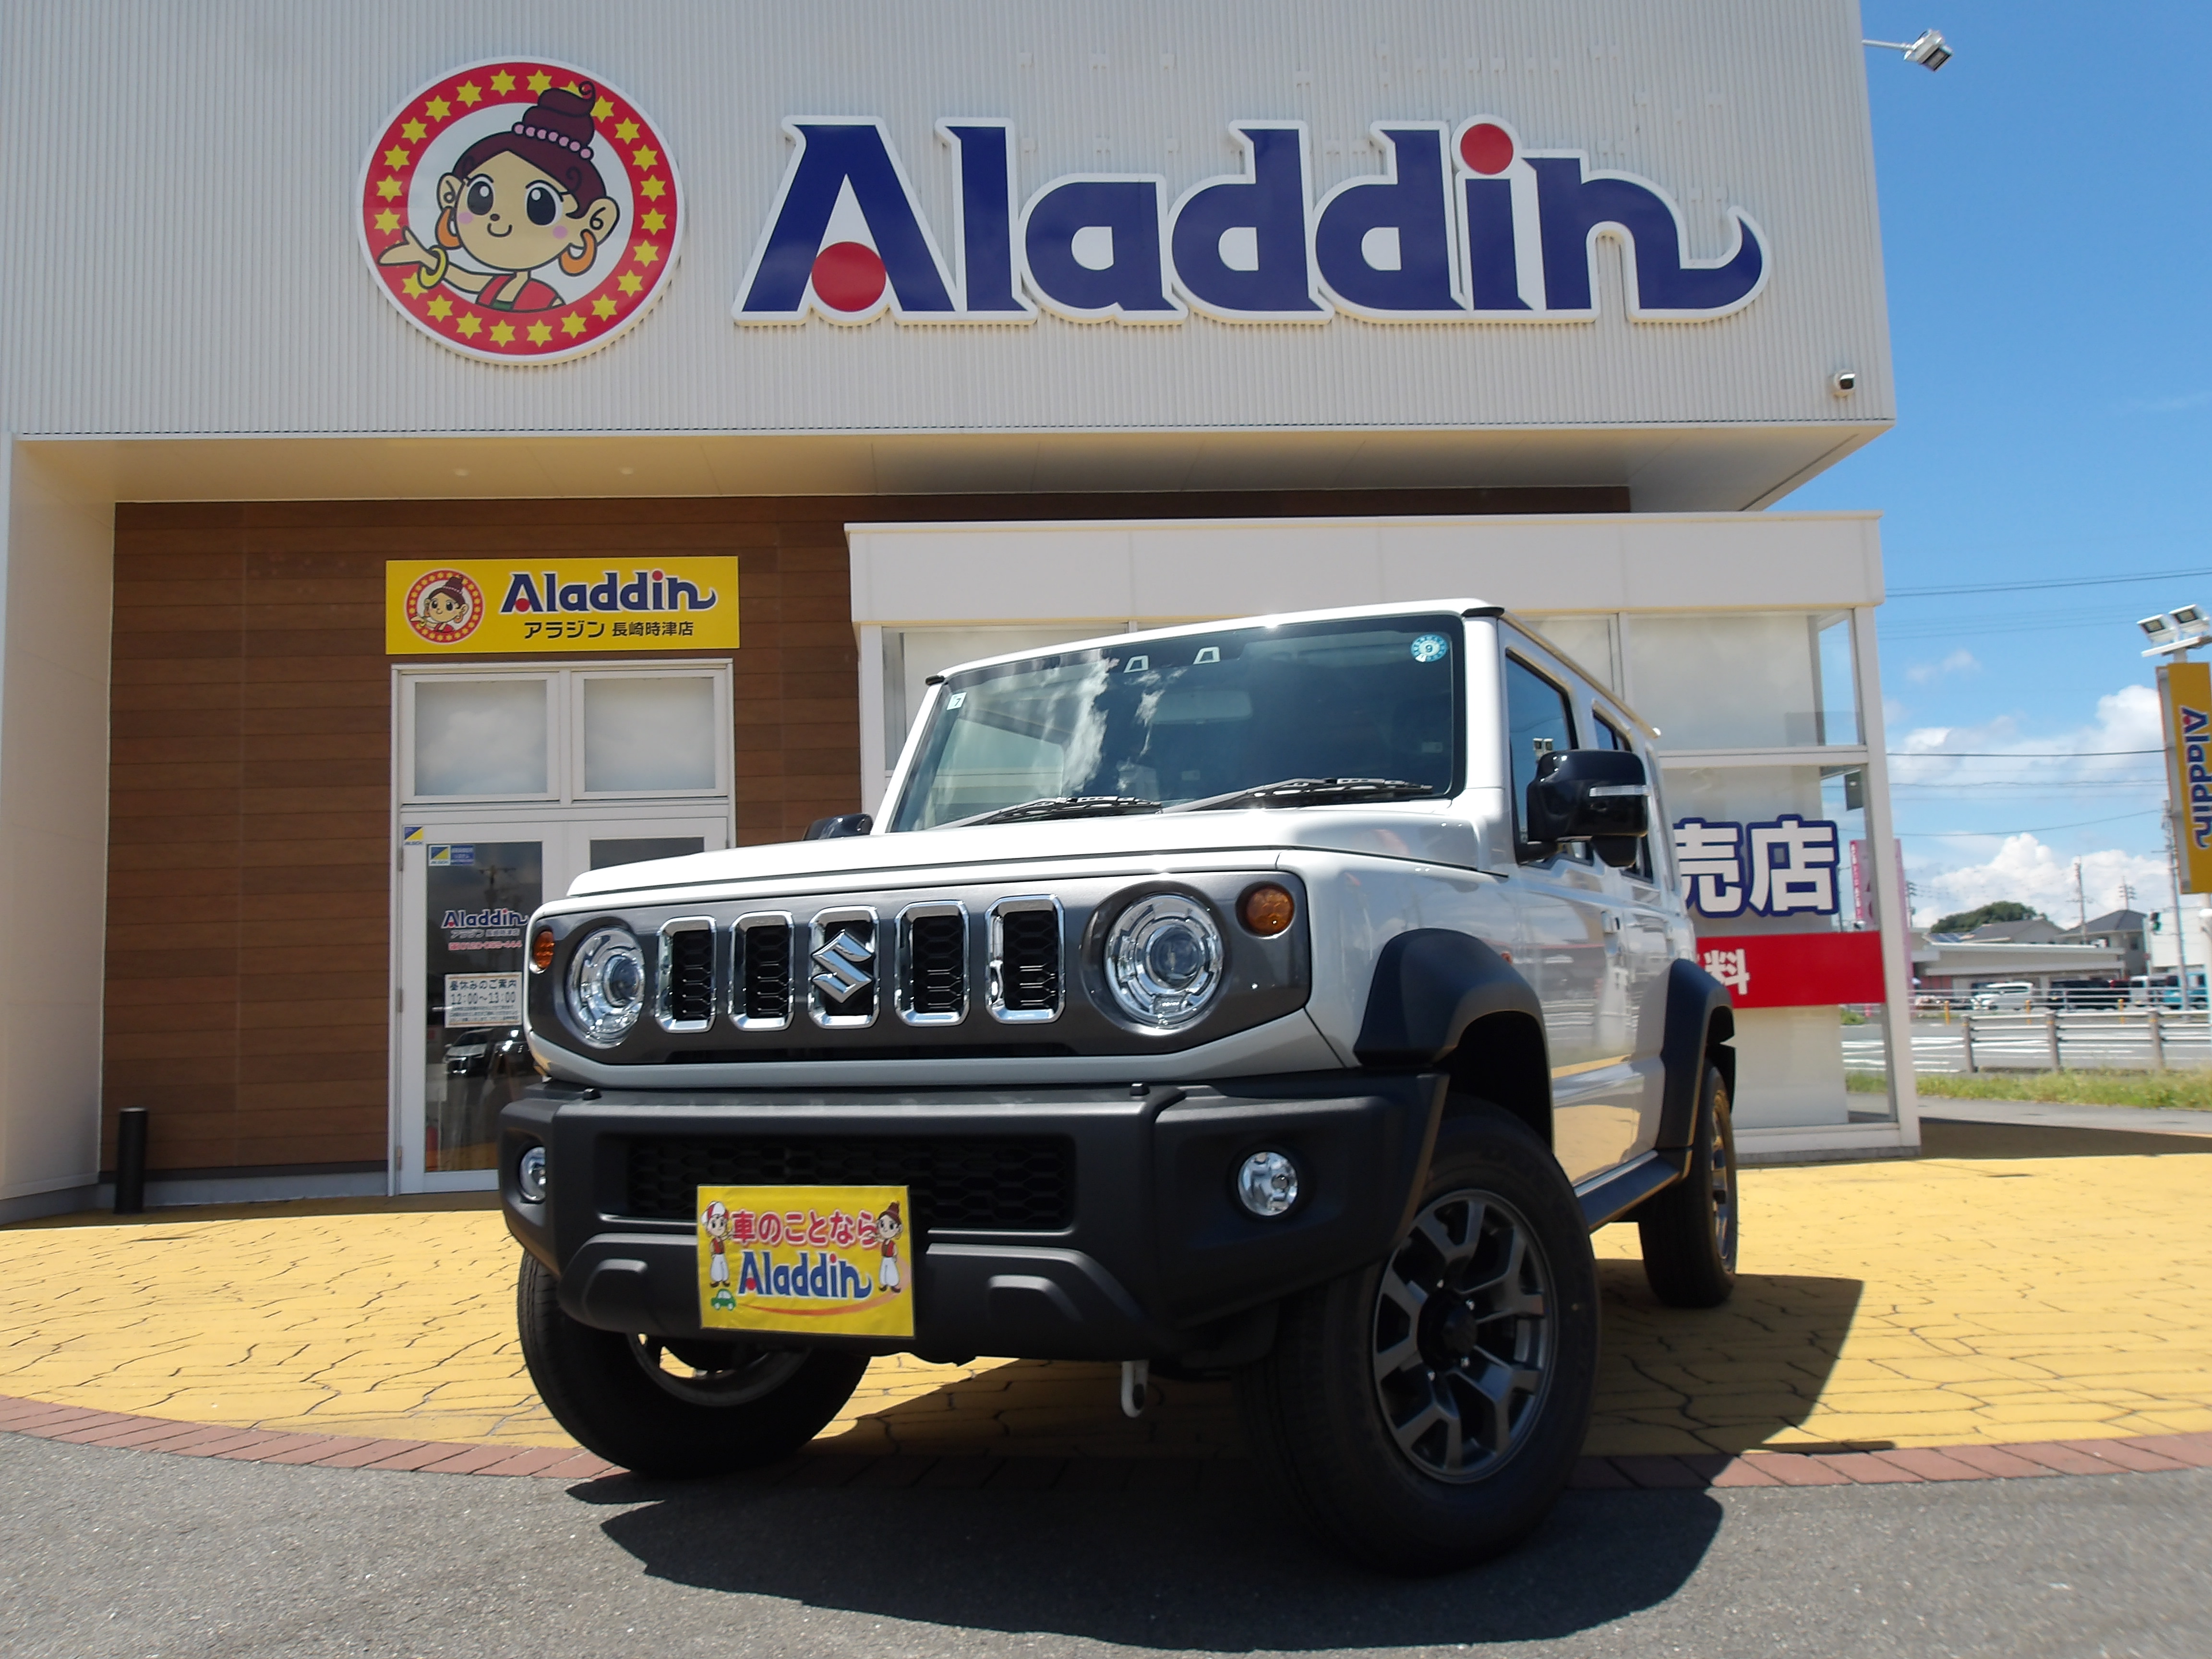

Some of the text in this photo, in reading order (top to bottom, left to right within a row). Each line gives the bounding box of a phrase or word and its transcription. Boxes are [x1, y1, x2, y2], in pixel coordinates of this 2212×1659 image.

[733, 114, 1772, 325] Aladdin
[499, 569, 717, 614] Aladdin
[524, 620, 694, 639] アラジン 長崎時津店
[441, 909, 528, 928] Aladdin
[450, 979, 517, 990] 昼休みのご案内
[730, 1209, 878, 1250] 車のことなら
[737, 1250, 873, 1299] Aladdin
